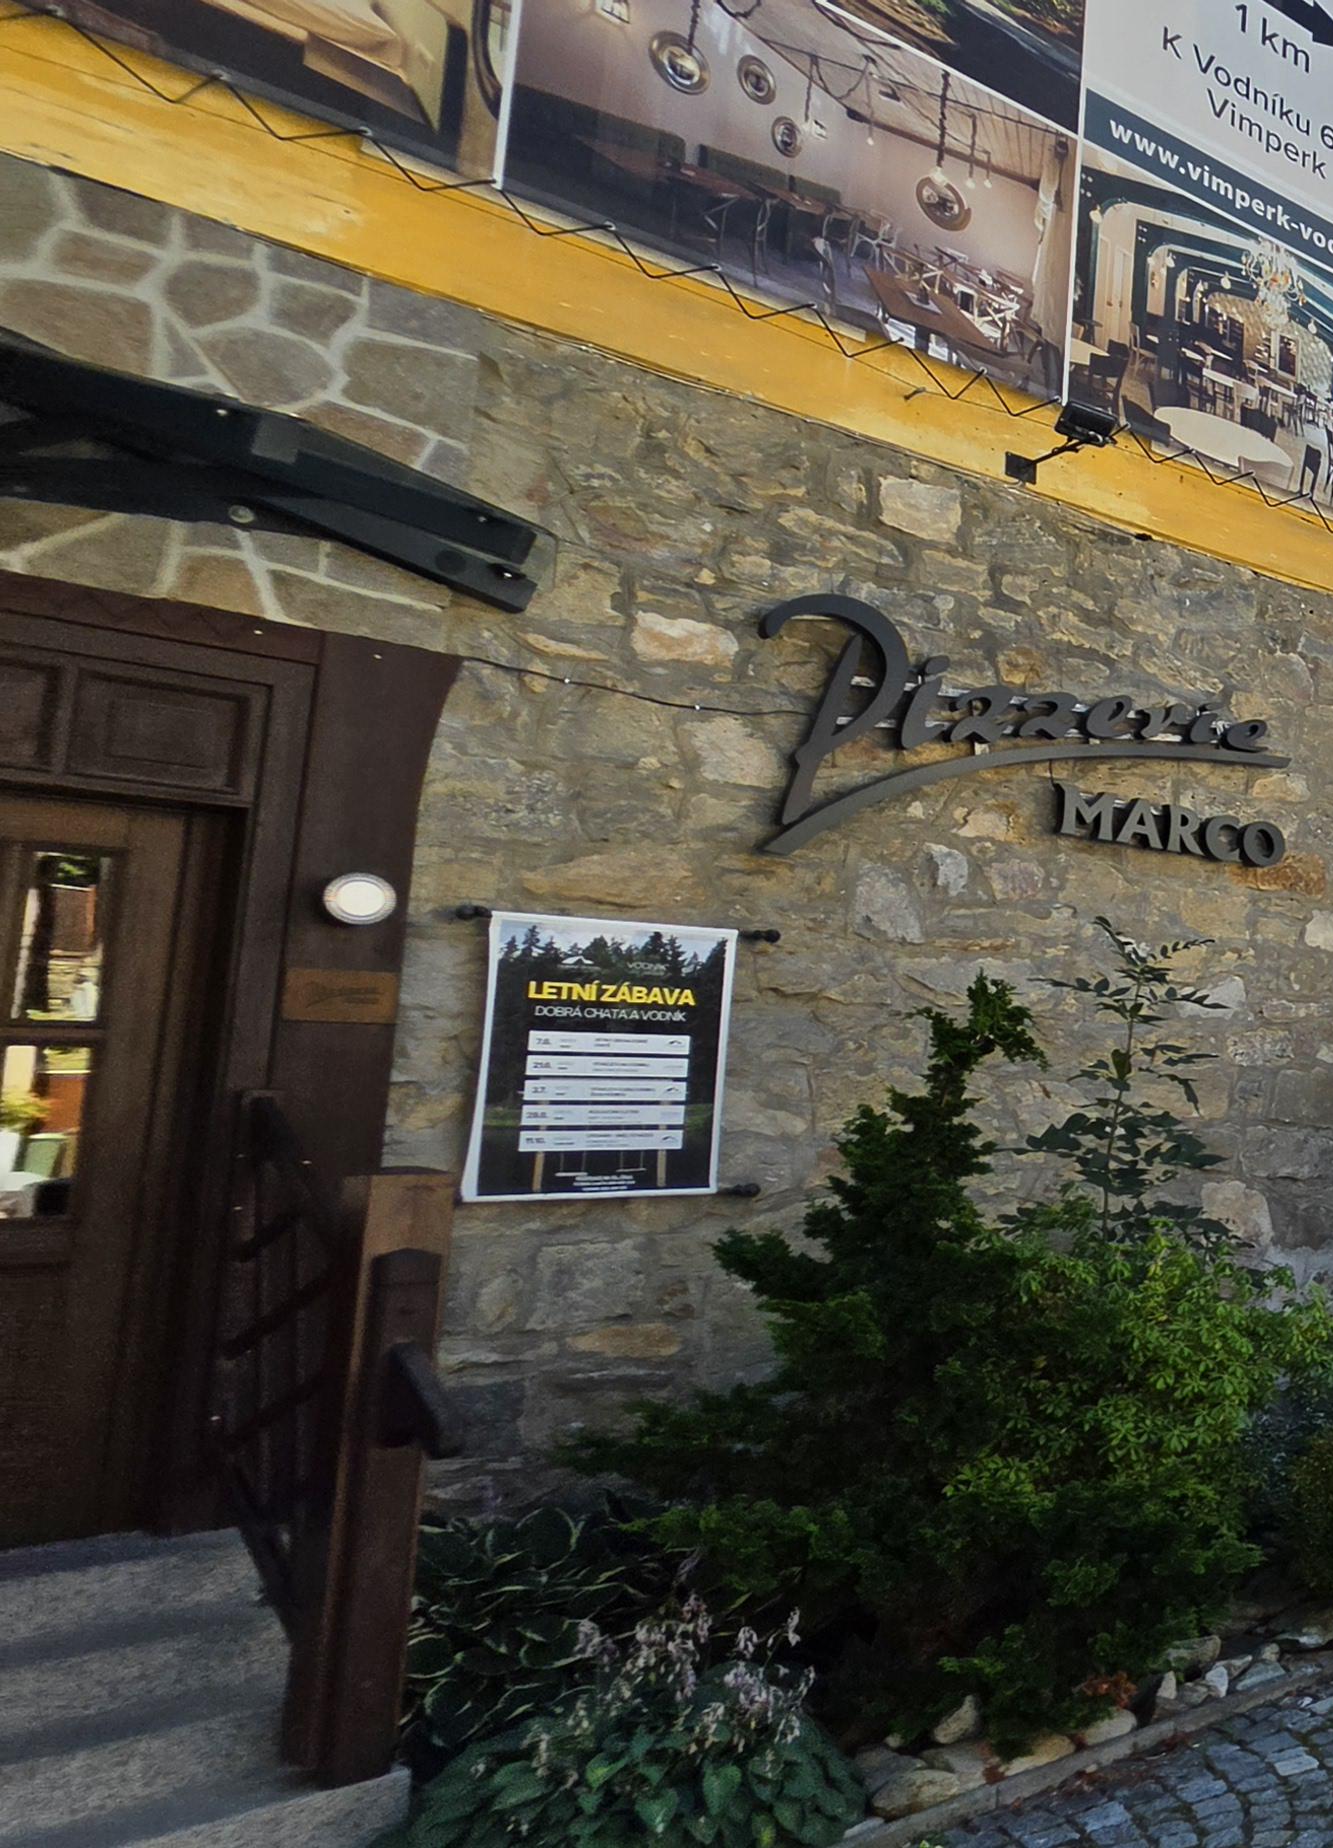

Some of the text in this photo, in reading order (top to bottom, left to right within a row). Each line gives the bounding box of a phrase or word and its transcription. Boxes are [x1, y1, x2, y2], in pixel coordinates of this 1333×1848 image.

[1235, 3, 1311, 73] 1 km
[1193, 43, 1311, 136] Vodníku
[1206, 87, 1327, 180] Vimperk
[757, 592, 1272, 826] Pizzerie
[1056, 783, 1287, 868] MARCO
[528, 980, 696, 1006] LETNÍ ZÁBAVA
[534, 1005, 687, 1022] DOBRÁ CHATA A VODNÍK
